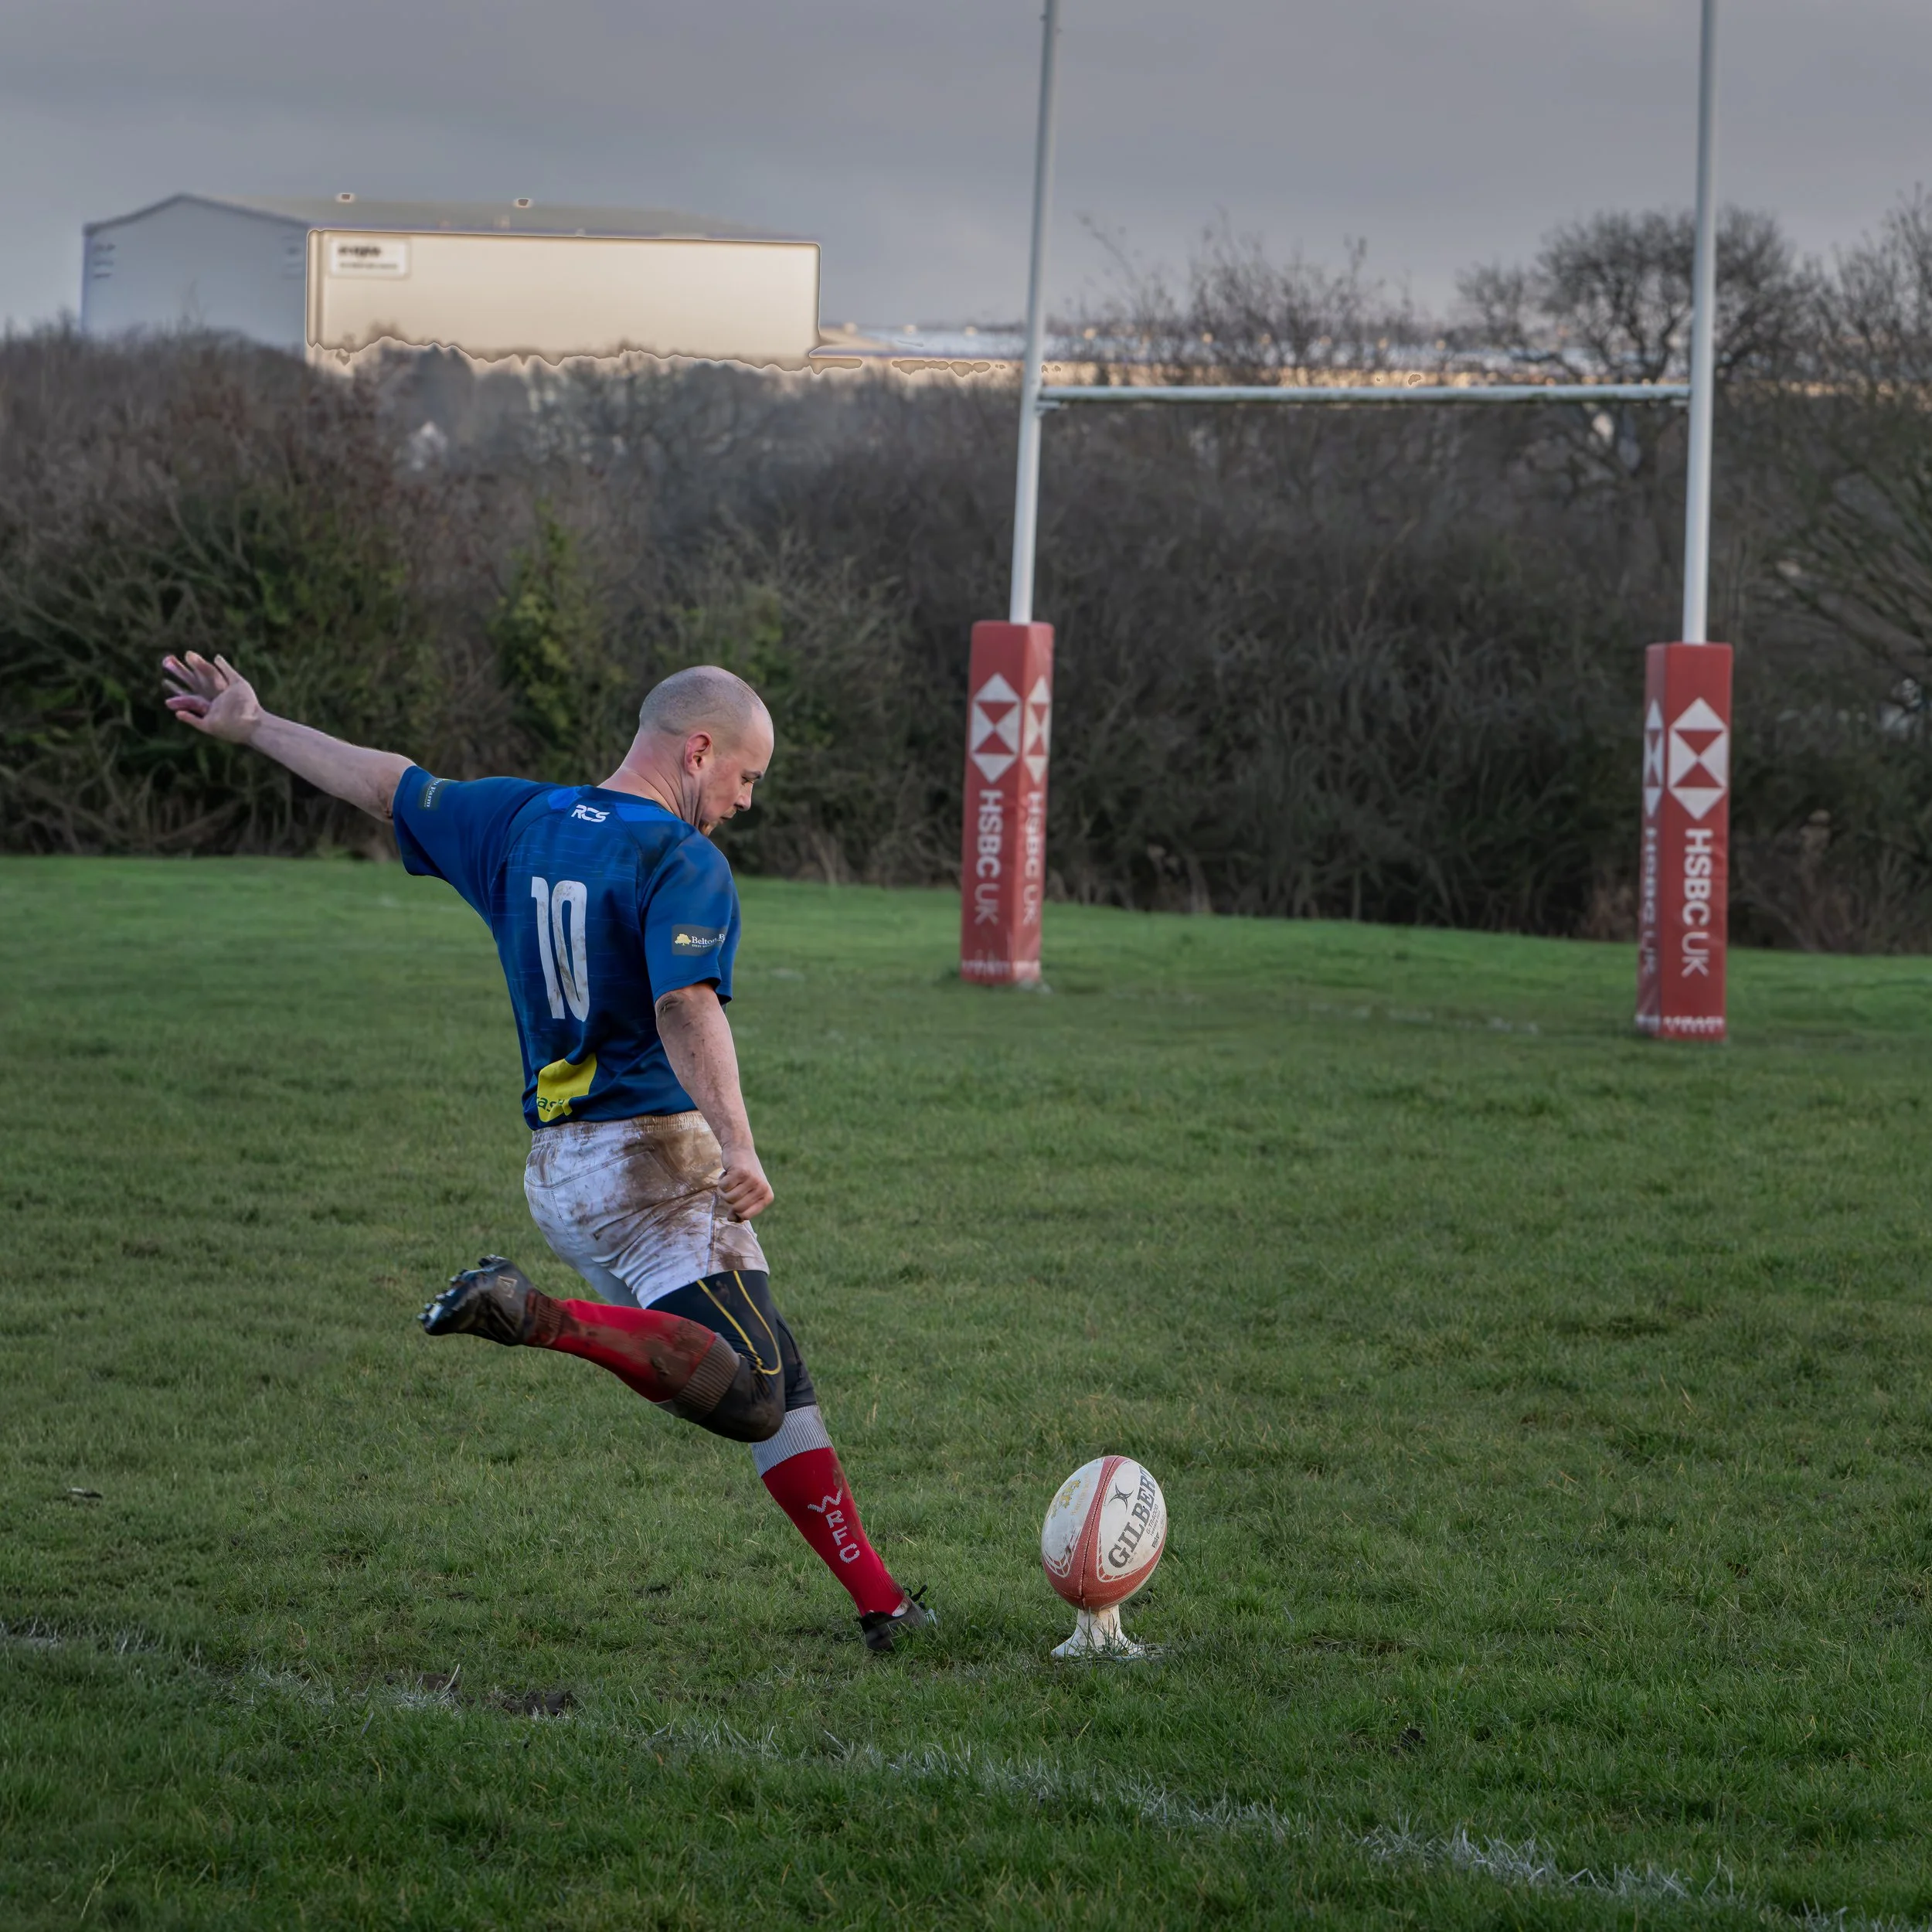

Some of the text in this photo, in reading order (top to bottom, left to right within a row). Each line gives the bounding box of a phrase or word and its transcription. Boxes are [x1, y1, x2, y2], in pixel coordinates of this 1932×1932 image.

[571, 804, 611, 823] RCS
[974, 789, 1003, 926] HSBC UK
[1023, 791, 1043, 925] HSBC UK
[531, 876, 590, 1022] 10
[1681, 828, 1713, 978] HSBC UK
[808, 1487, 860, 1563] WRFC
